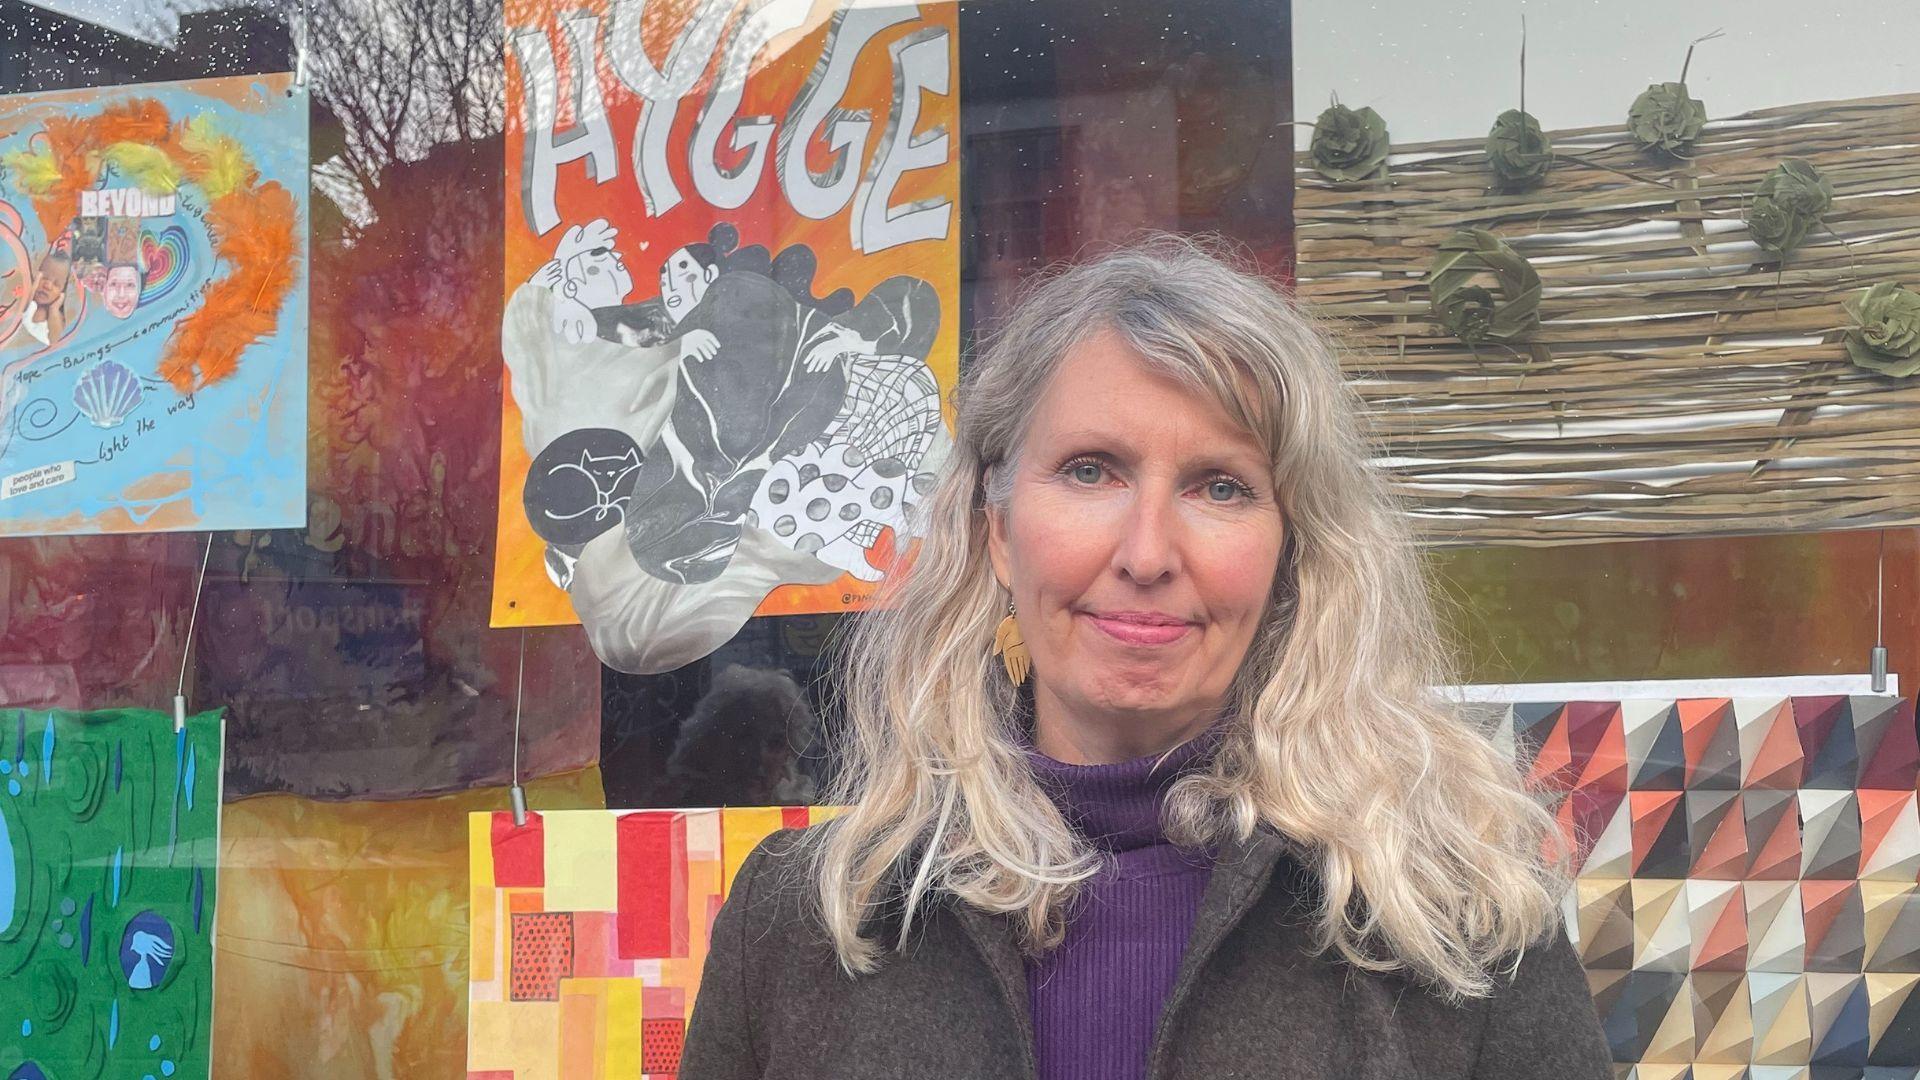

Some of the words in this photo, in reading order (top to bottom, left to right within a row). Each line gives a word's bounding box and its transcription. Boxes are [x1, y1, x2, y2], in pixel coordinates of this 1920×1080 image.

[513, 0, 953, 256] HYGGE
[82, 188, 176, 217] BEYOND
[98, 434, 130, 461] light
[167, 393, 195, 415] way
[10, 484, 28, 495] love
[29, 477, 44, 490] and
[46, 474, 65, 485] care
[13, 469, 42, 486] people
[44, 464, 62, 476] who
